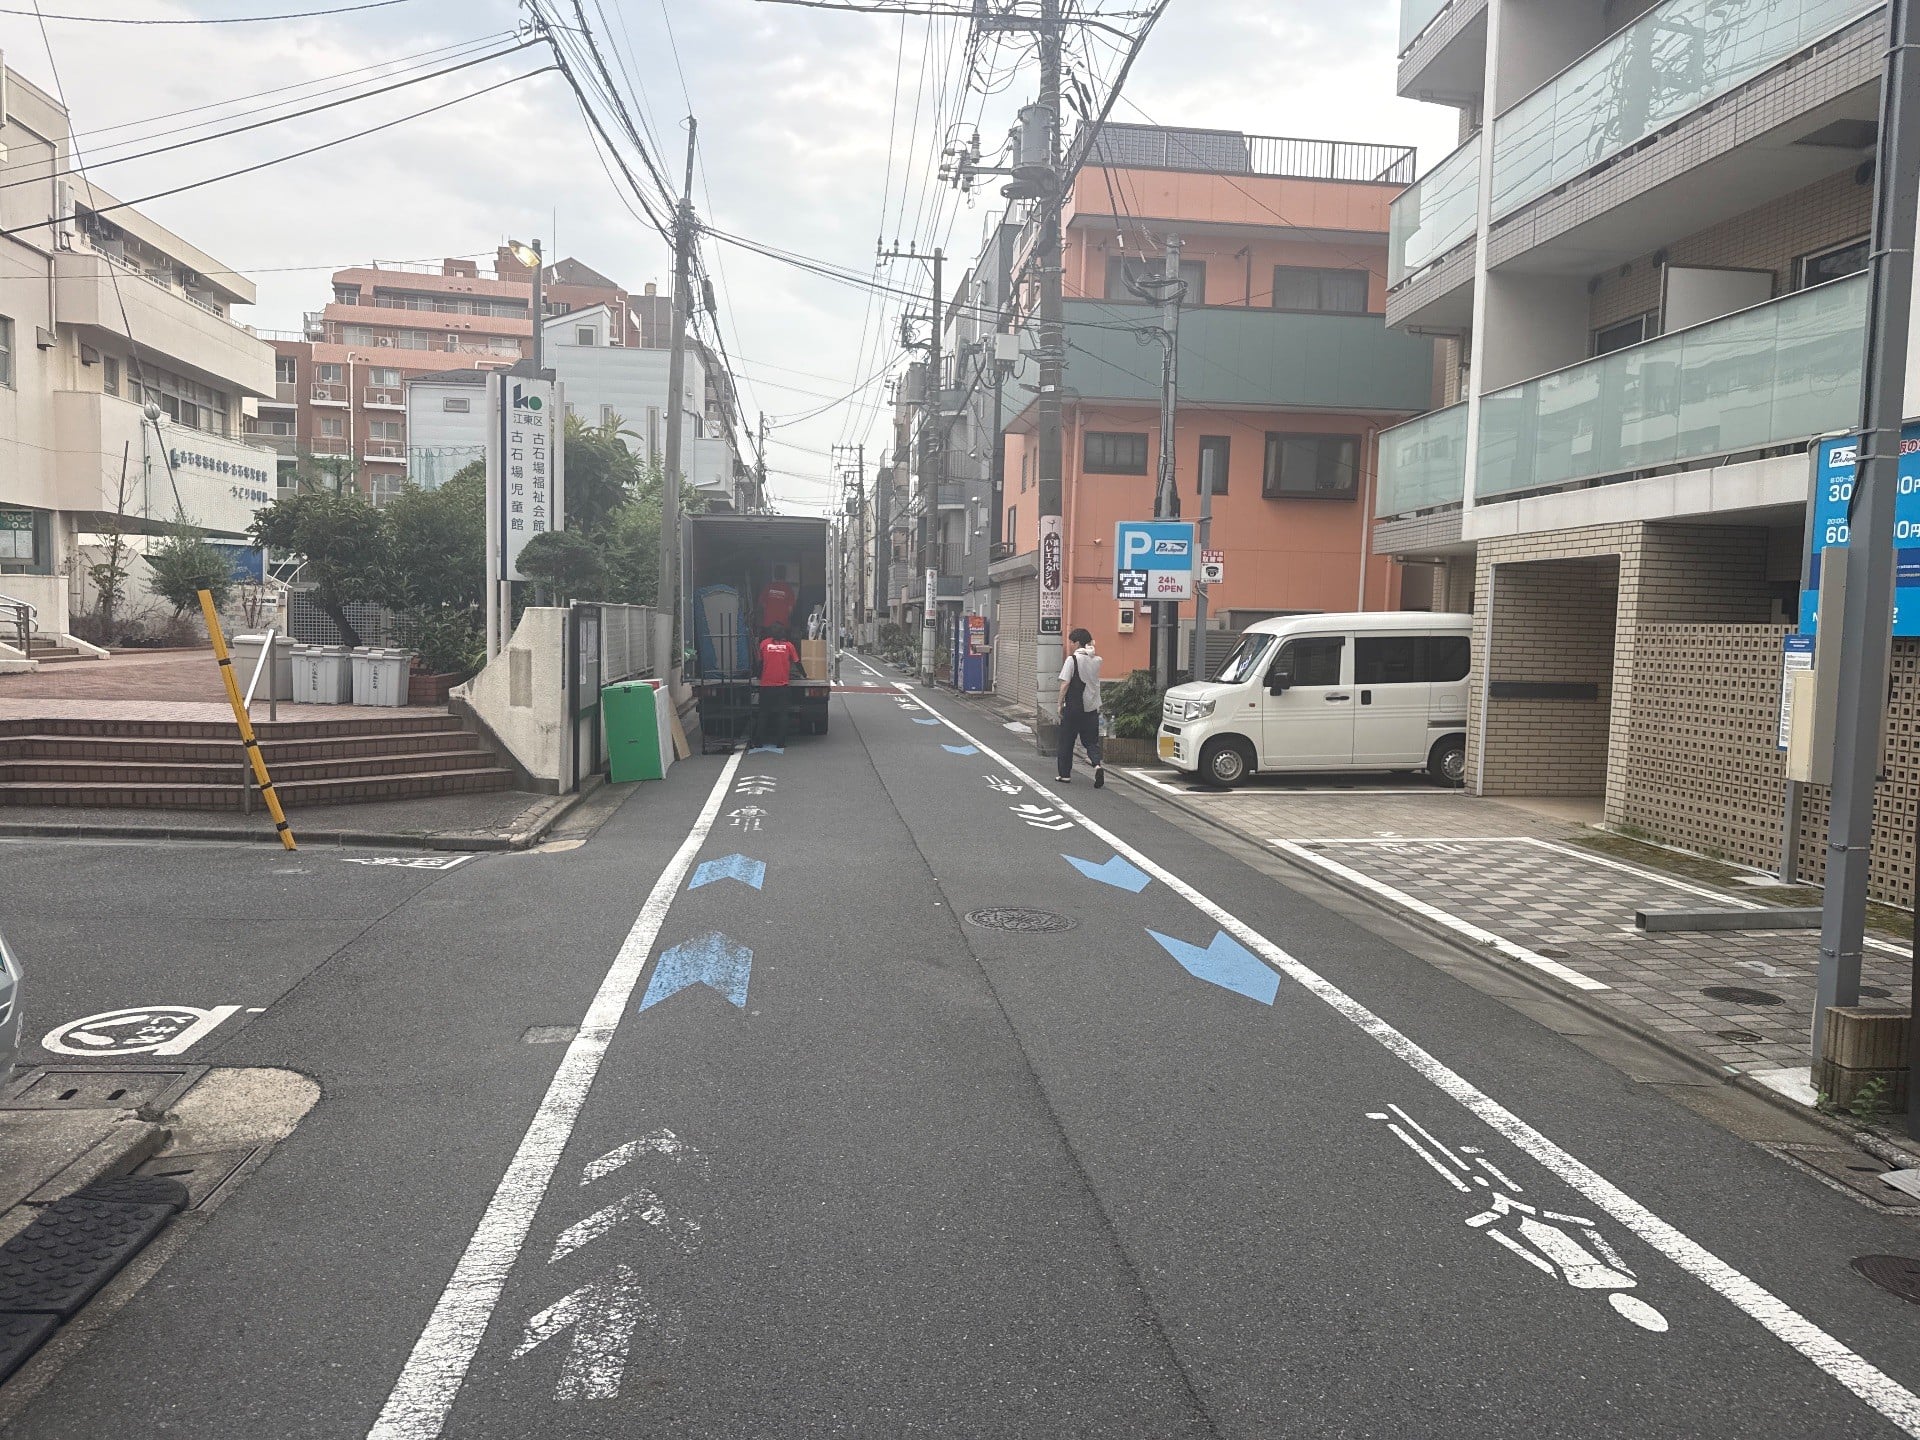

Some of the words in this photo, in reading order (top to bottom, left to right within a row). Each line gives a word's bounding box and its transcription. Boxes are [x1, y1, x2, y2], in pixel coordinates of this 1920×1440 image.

[513, 413, 543, 427] 江東区
[511, 431, 524, 531] 古石場児童館
[532, 433, 545, 532] 古石場福祉会館
[1124, 531, 1152, 570] P
[1119, 570, 1147, 598] 空
[1157, 585, 1183, 593] OPEN
[1158, 576, 1176, 584] 24h
